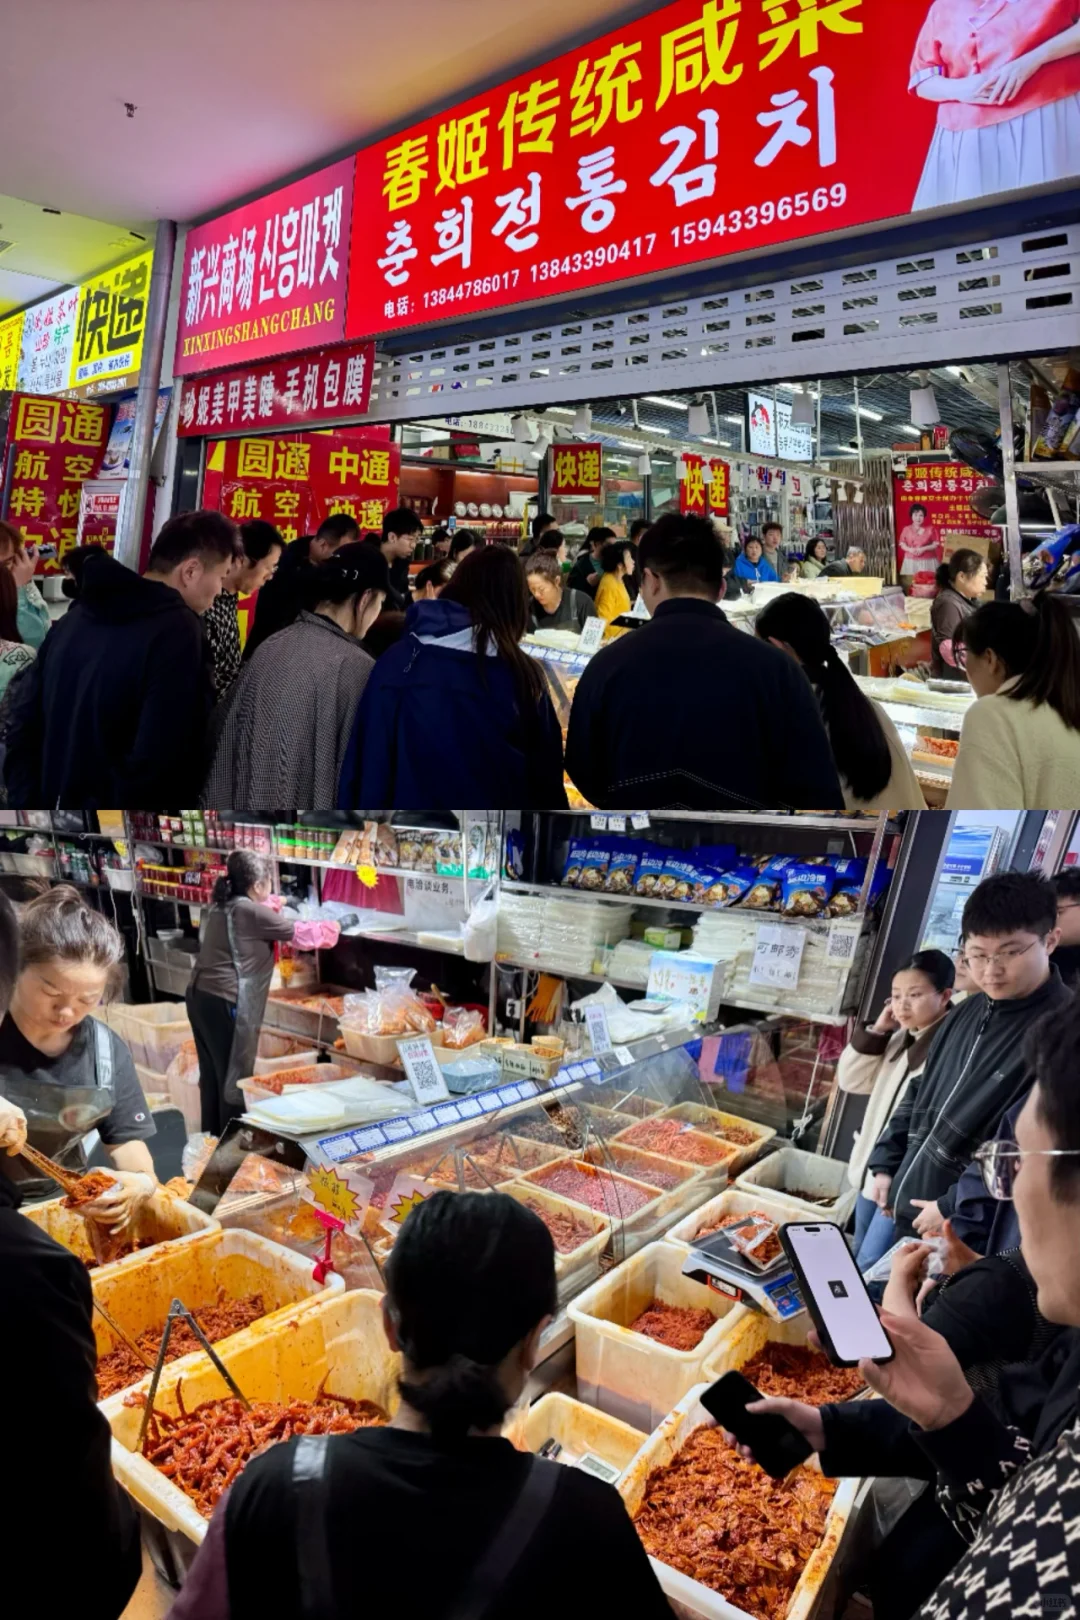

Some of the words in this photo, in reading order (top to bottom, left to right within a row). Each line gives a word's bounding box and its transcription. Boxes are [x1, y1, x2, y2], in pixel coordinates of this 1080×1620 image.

[422, 269, 520, 309] 13844786017
[529, 233, 656, 284] 13843390417
[670, 182, 848, 248] 15943396569
[184, 224, 257, 327] 新兴商场
[182, 298, 336, 357] XINXINGSHANGCHANG
[285, 353, 366, 416] 手机包膜
[15, 397, 105, 446] 圆通
[14, 450, 94, 482] 航空
[238, 438, 310, 482] 圆通
[328, 445, 390, 487] 中通
[555, 452, 601, 488] 快递
[684, 460, 726, 508] 快递
[229, 488, 300, 518] 航空
